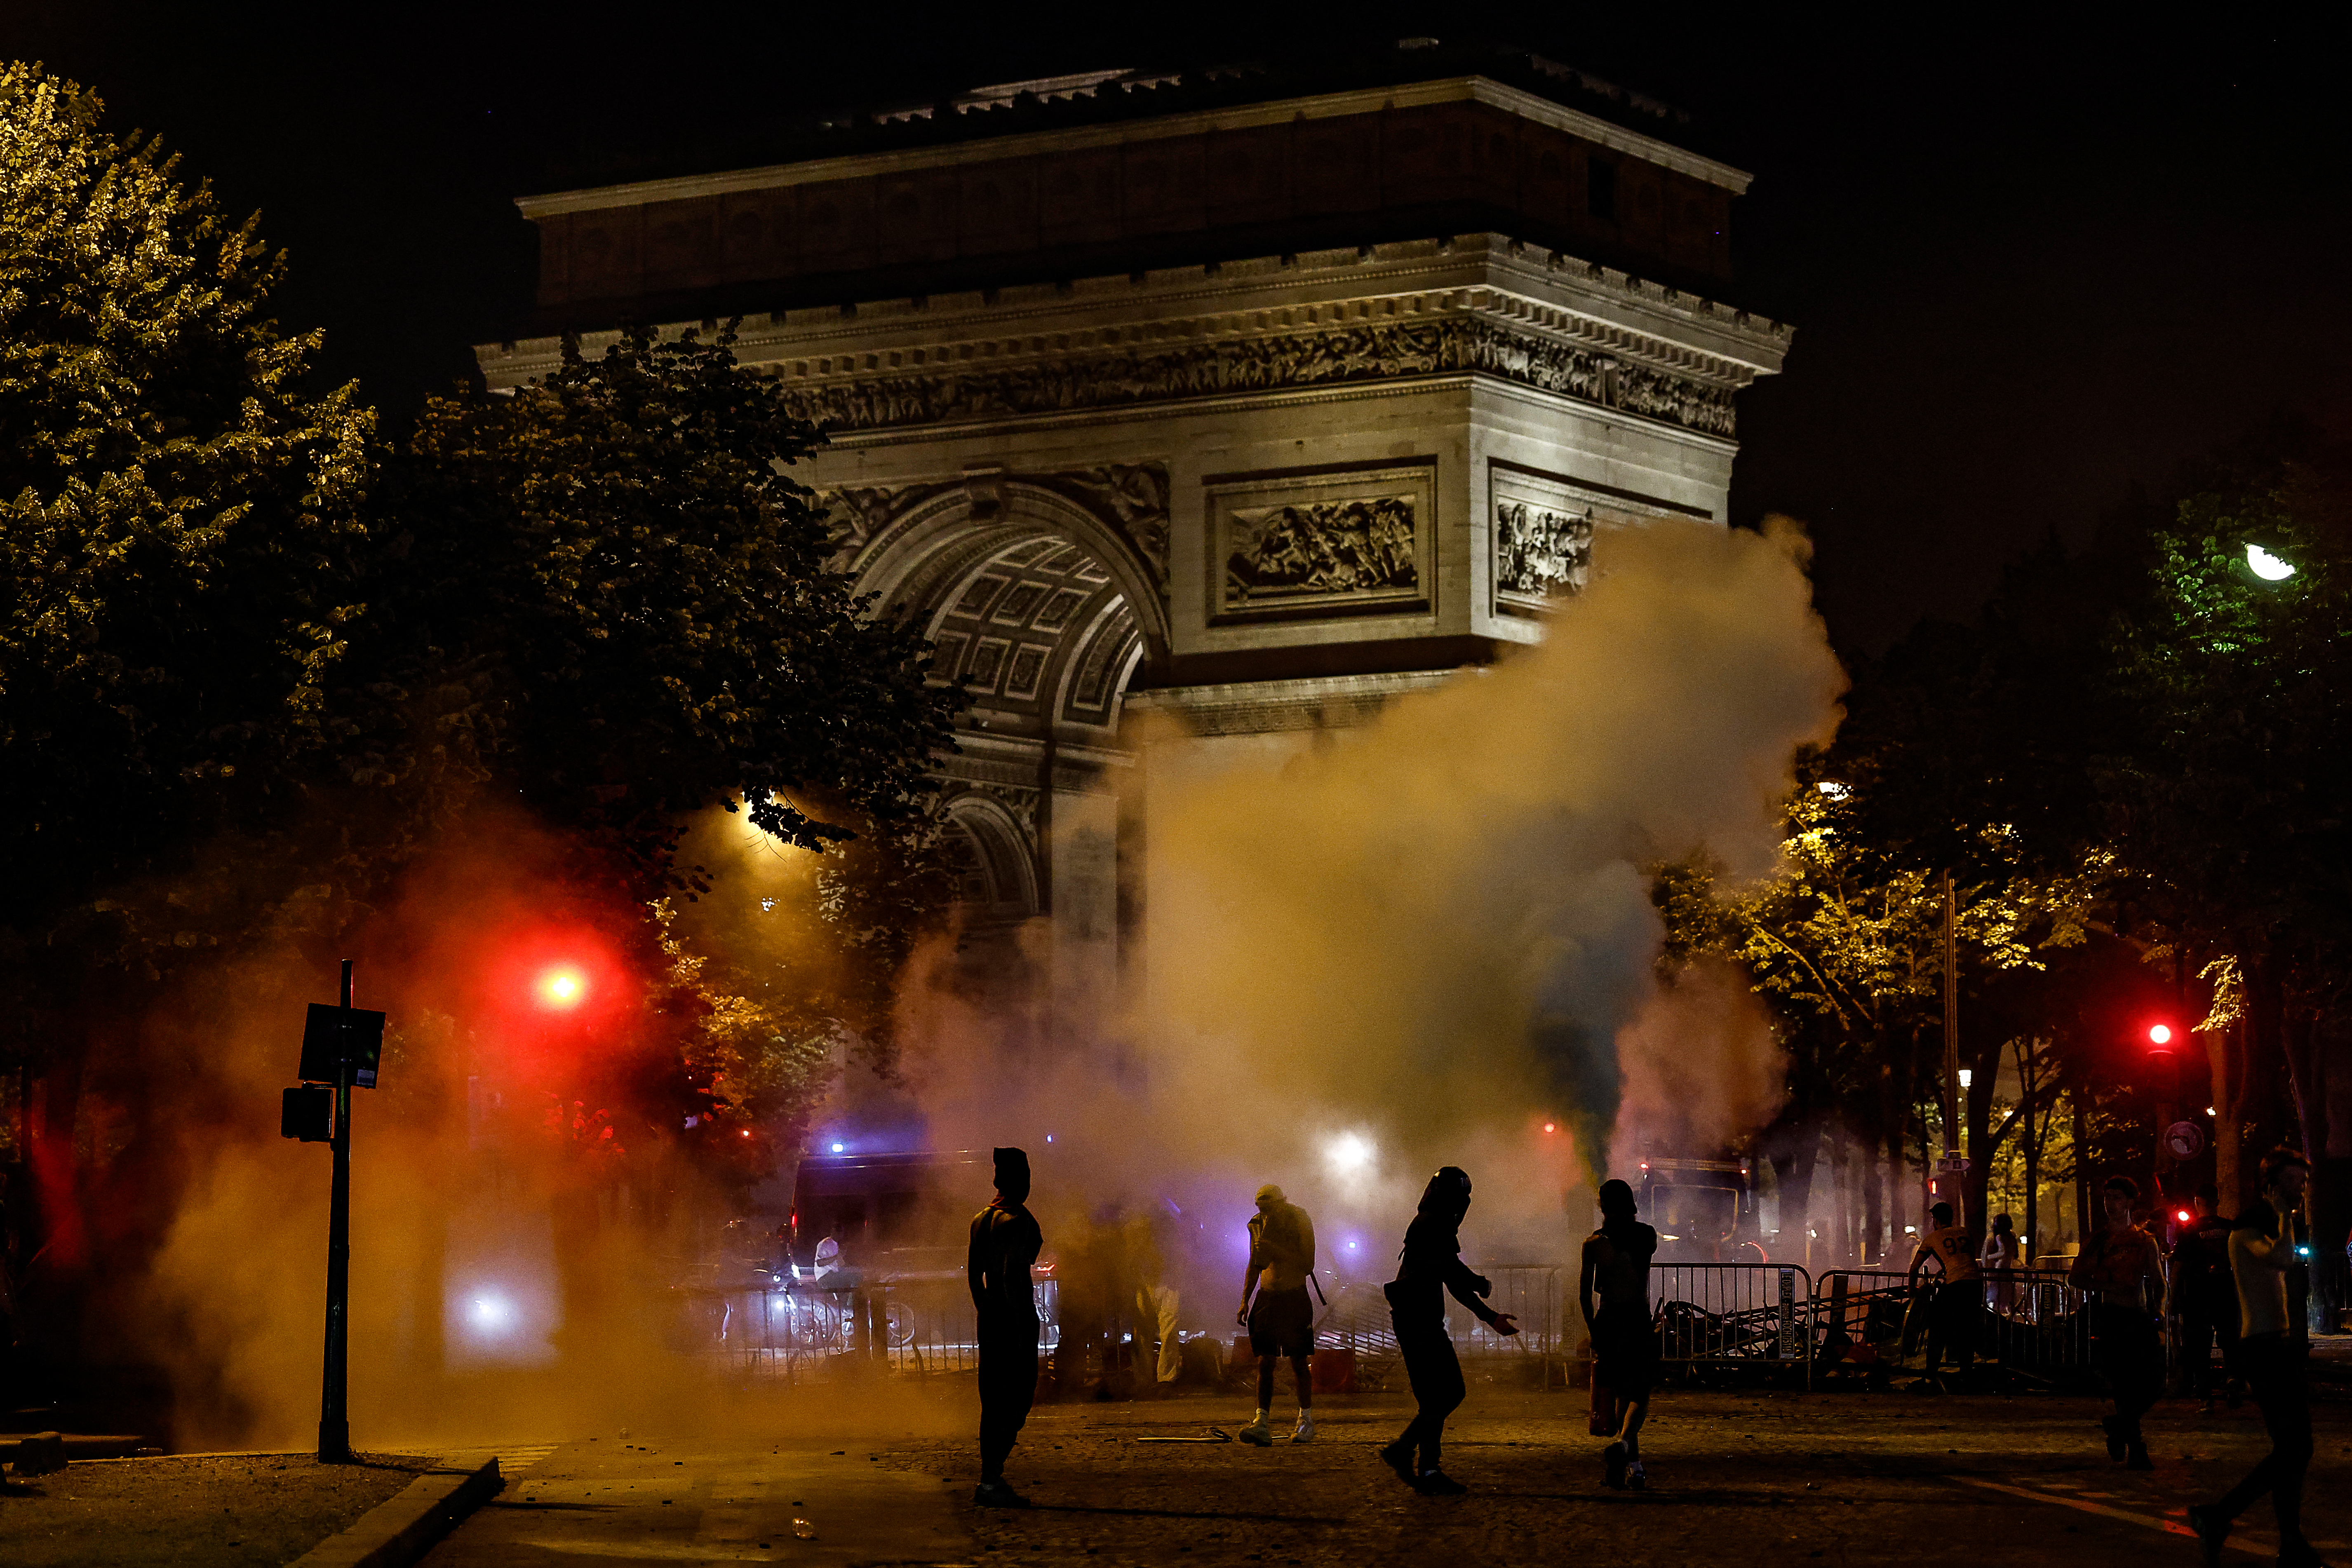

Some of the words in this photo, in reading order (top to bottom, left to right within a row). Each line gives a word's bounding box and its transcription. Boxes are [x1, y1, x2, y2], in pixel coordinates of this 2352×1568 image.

[1943, 1237, 1975, 1254] 92
[1781, 1279, 1792, 1299] DUPLEX
[1781, 1303, 1790, 1319] avenue
[1782, 1320, 1792, 1334] FOCH
[1782, 1335, 1793, 1354] (75116)
